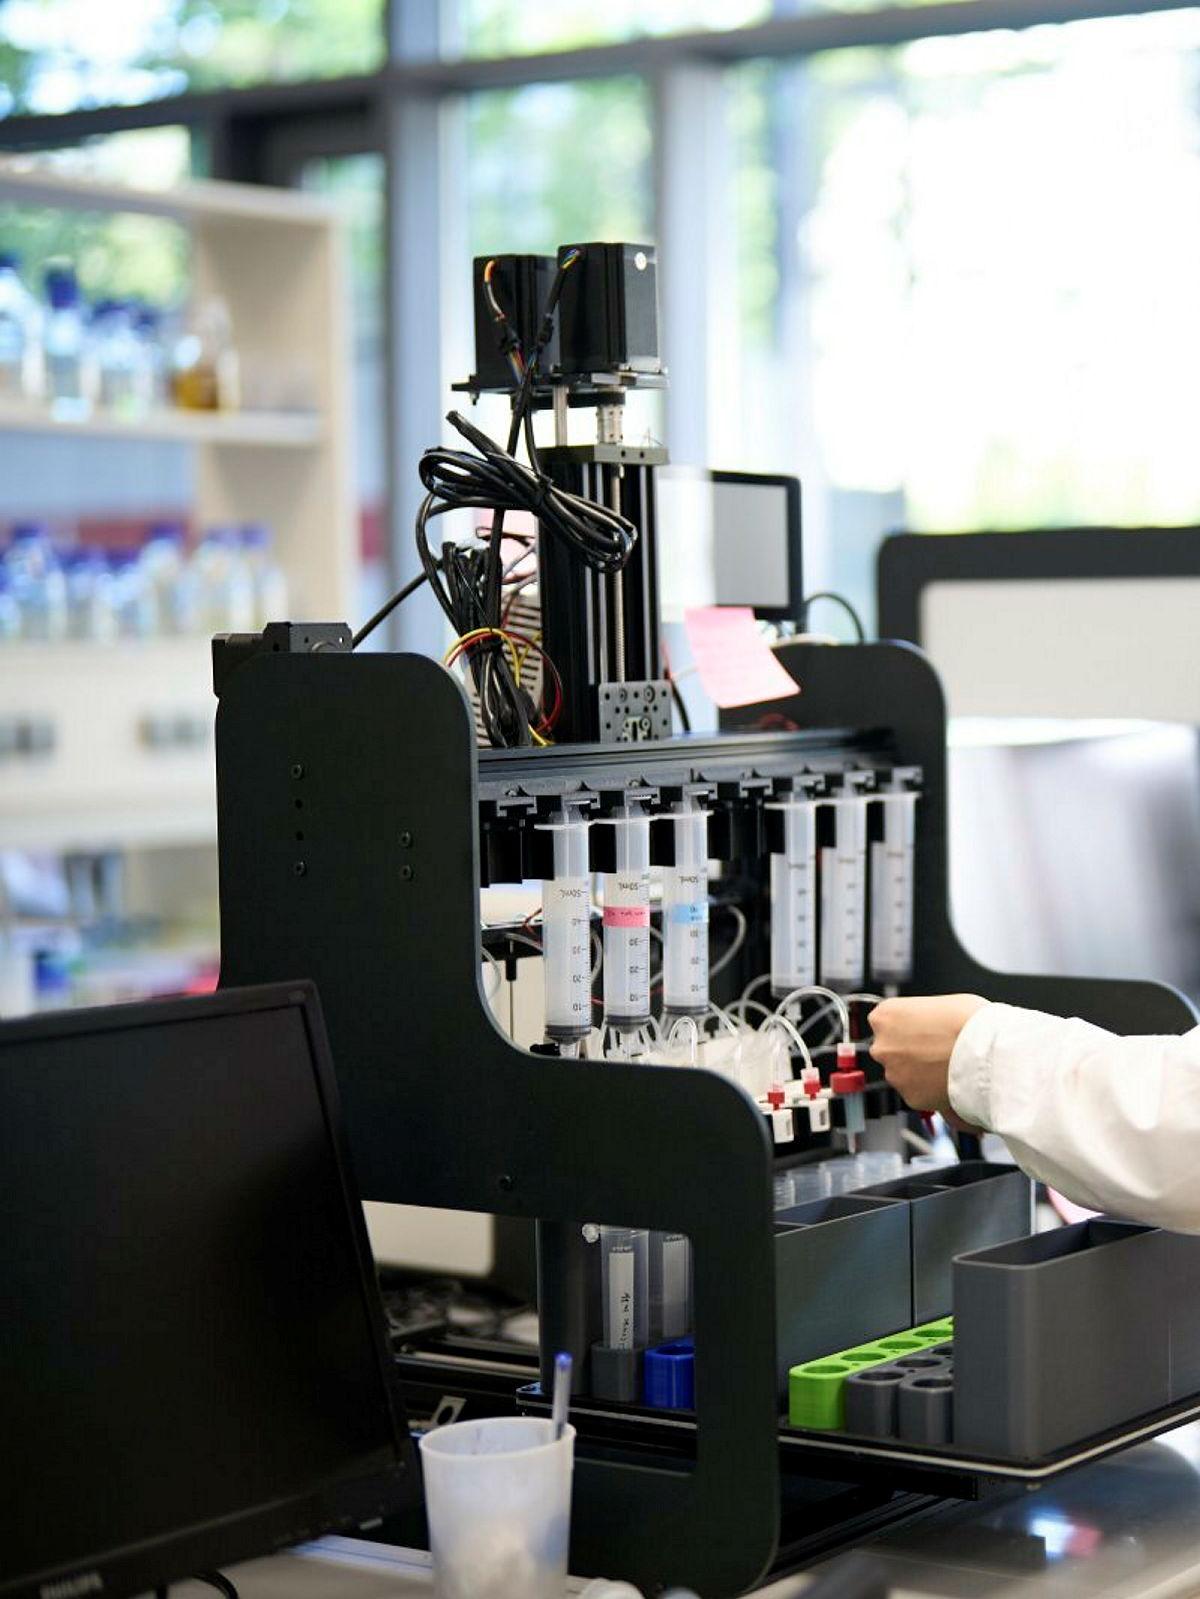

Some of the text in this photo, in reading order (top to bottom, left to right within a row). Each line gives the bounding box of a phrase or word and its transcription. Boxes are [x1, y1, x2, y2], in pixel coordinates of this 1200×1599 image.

[618, 882, 639, 890] 50mL
[560, 890, 582, 898] 50mL
[629, 938, 639, 946] 30
